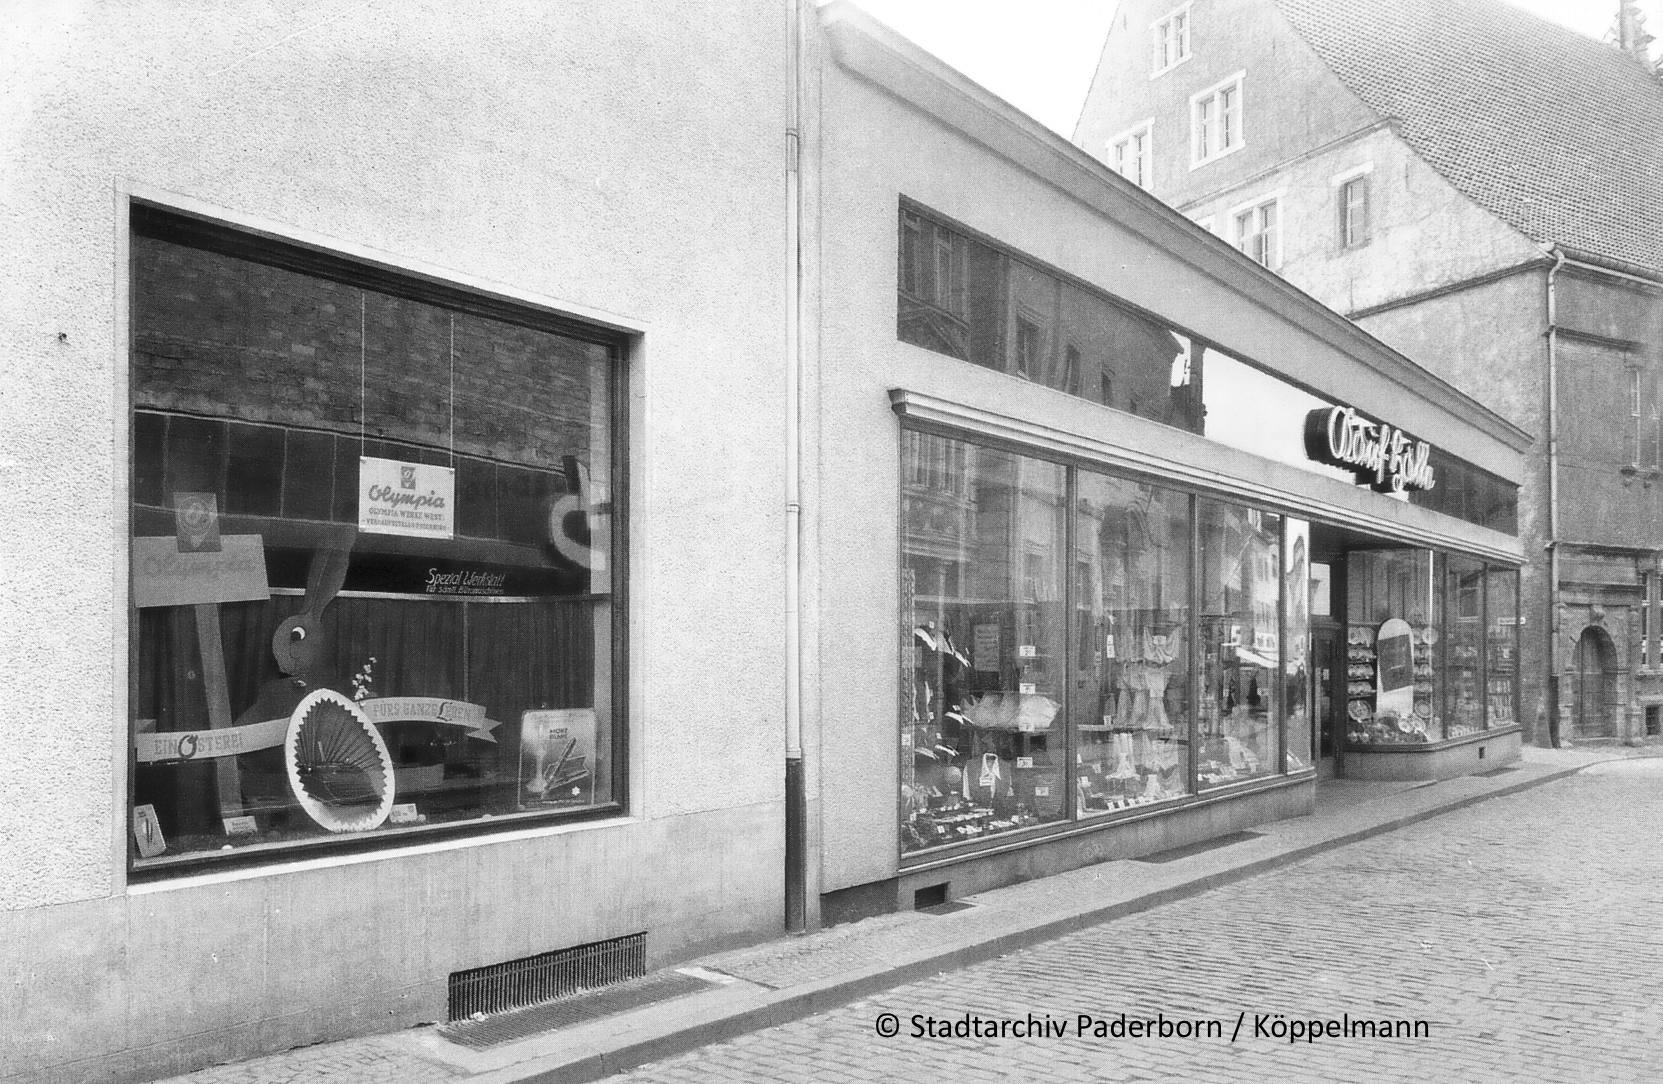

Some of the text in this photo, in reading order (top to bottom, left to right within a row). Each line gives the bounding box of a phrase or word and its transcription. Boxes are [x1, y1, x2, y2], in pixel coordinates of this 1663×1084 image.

[368, 484, 446, 511] Olympia
[368, 507, 399, 518] OLYMPIA
[425, 567, 463, 587] Spezial
[402, 703, 438, 717] GANZE
[437, 701, 472, 722] LEBEN
[154, 738, 178, 755] EIN
